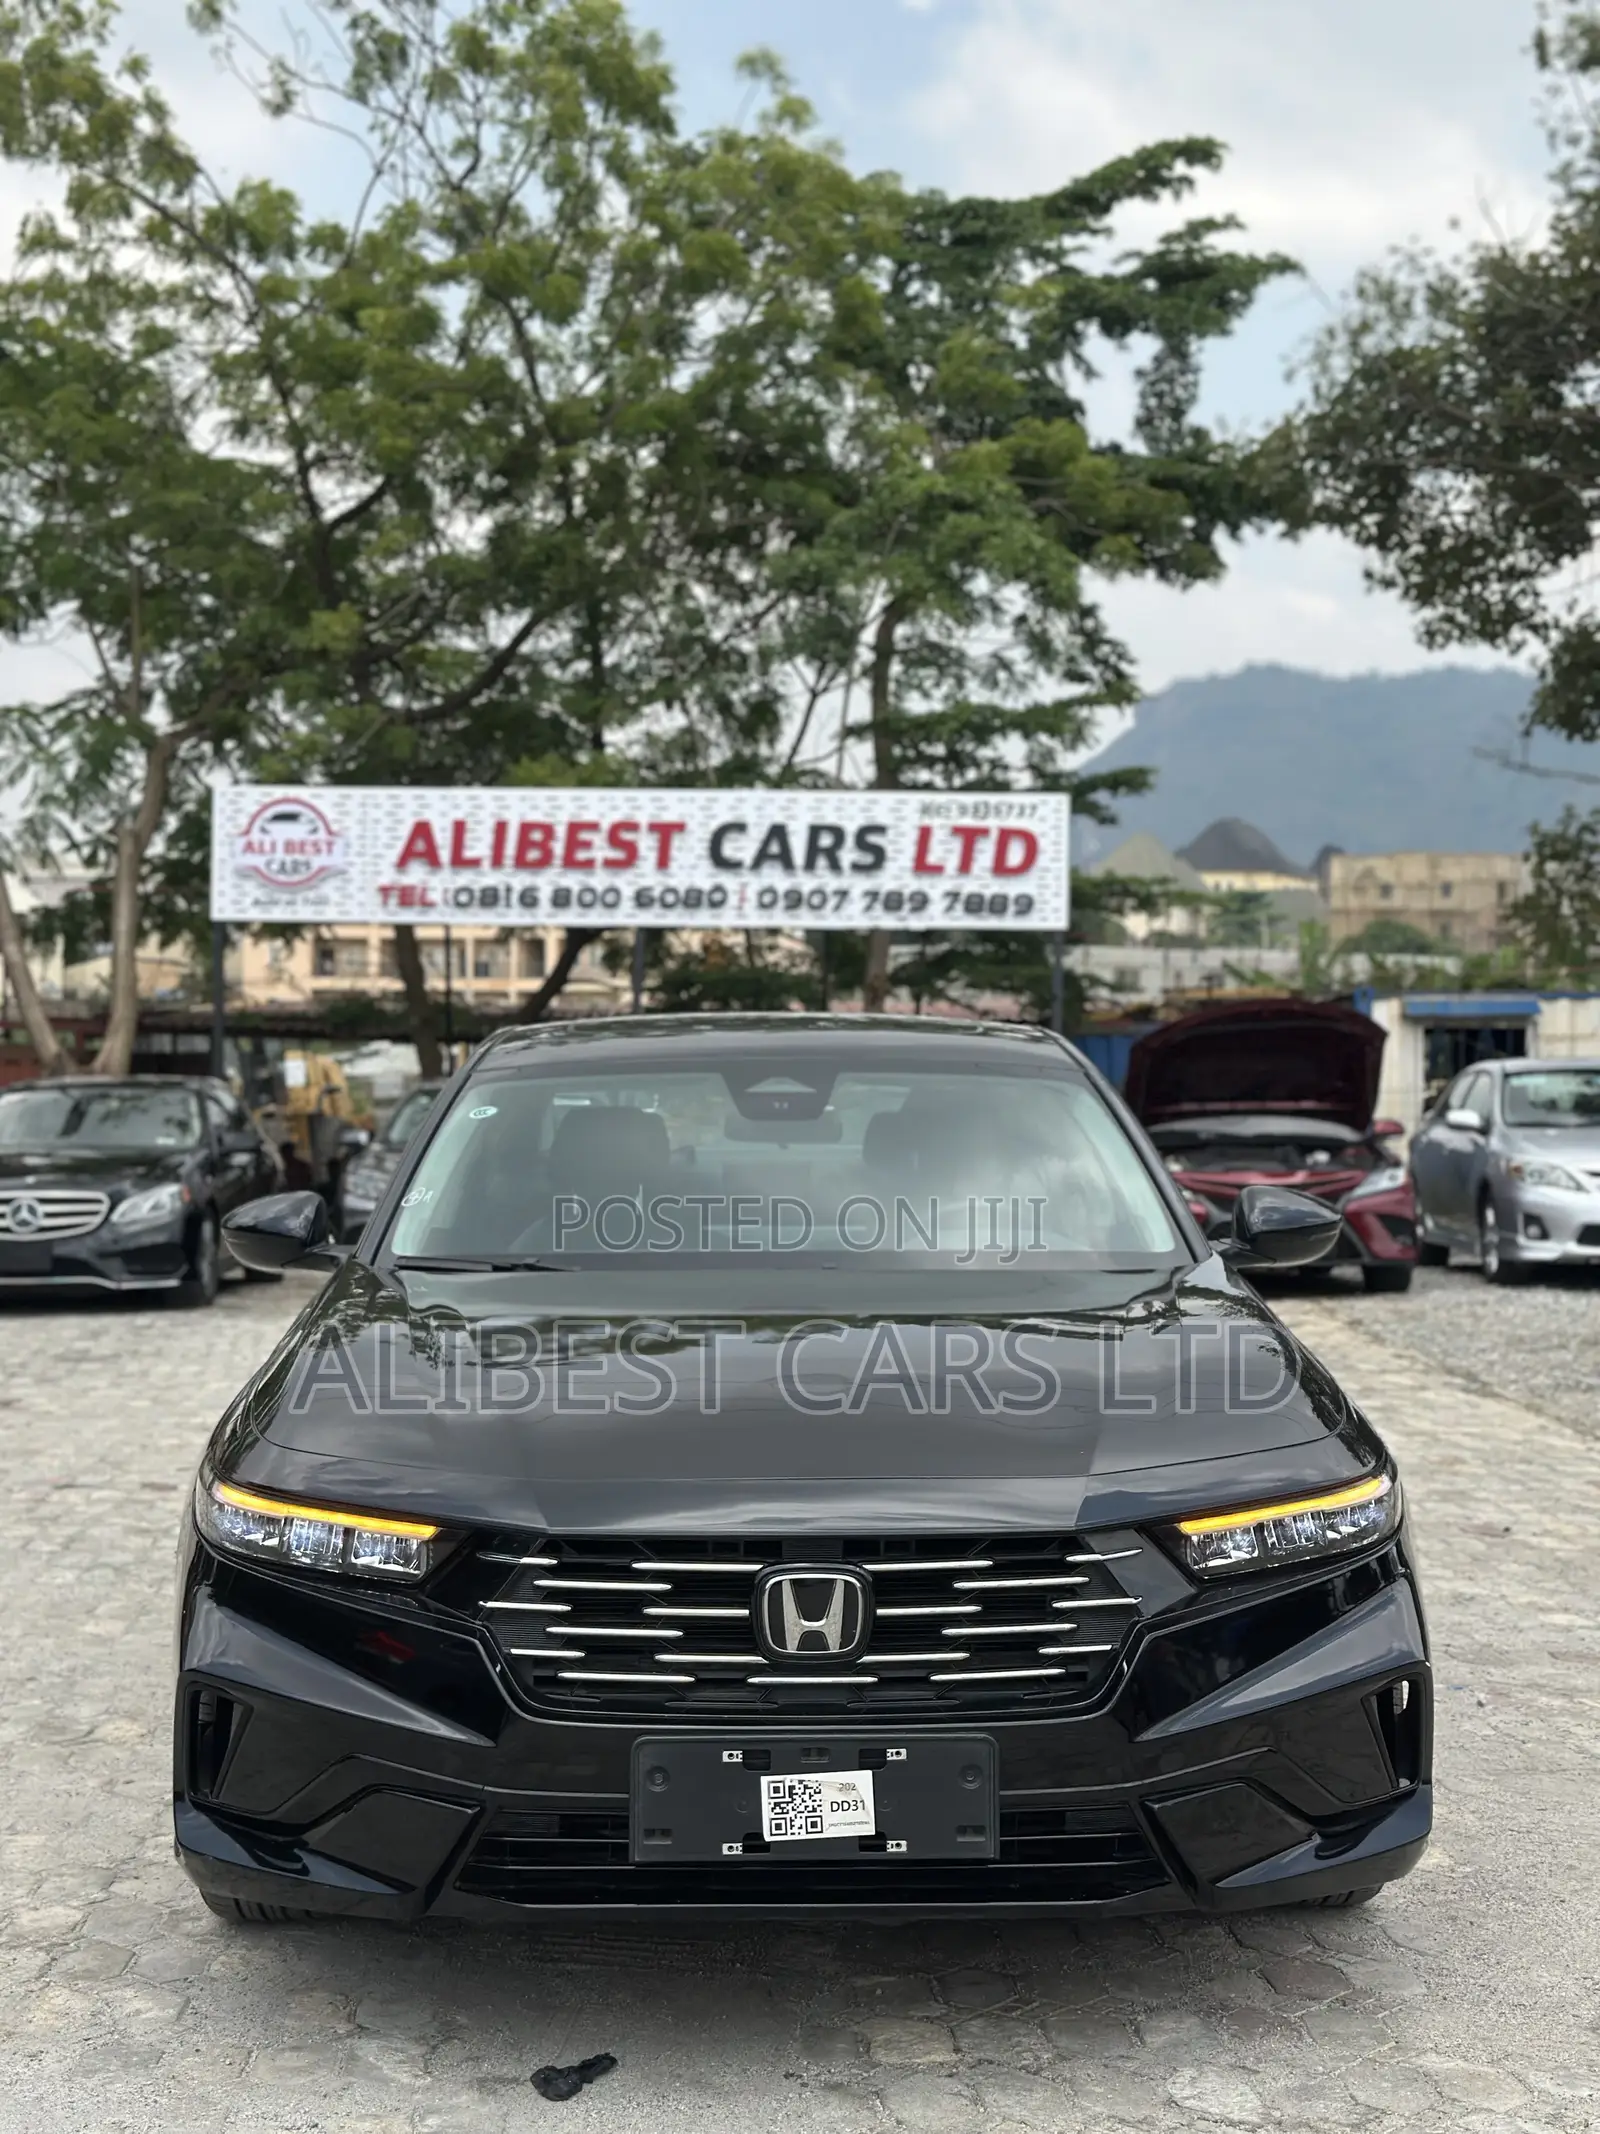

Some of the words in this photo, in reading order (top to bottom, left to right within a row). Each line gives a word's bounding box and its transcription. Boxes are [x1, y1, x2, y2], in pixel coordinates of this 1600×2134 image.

[242, 839, 276, 855] ALI
[283, 839, 334, 855] BEST
[395, 820, 687, 870] ALIBEST
[708, 821, 889, 872] CARS
[912, 823, 1041, 877] LTD
[264, 858, 311, 875] CARS
[454, 884, 540, 909] 0816
[552, 886, 622, 909] 800
[635, 885, 728, 910] 6080
[757, 886, 848, 912] 0907
[861, 889, 930, 914] 789
[942, 891, 1035, 916] 7889
[830, 1800, 866, 1813] DD31
